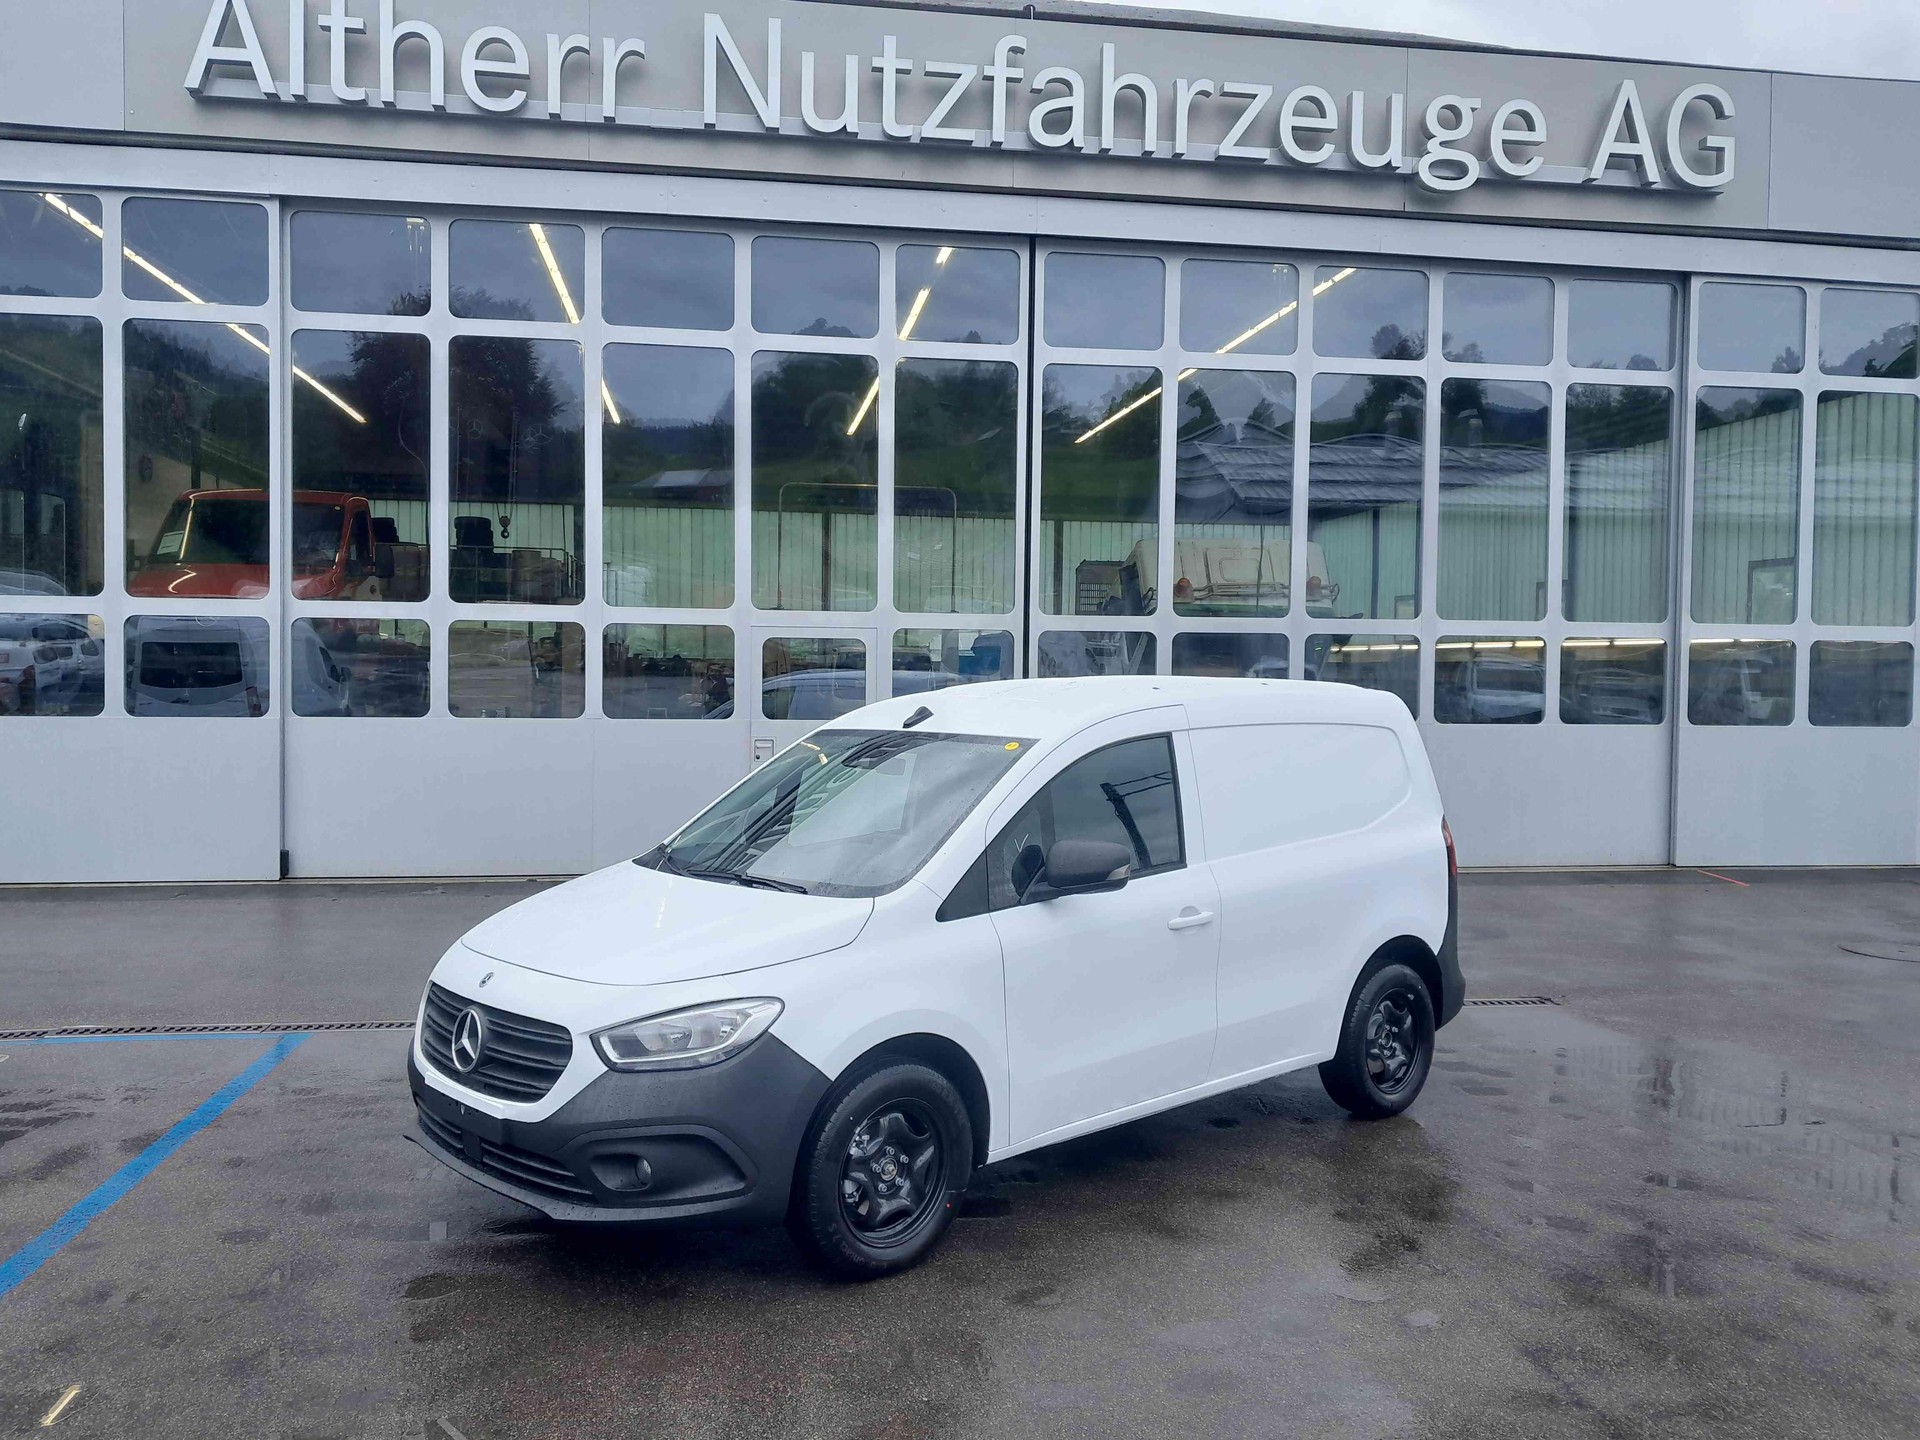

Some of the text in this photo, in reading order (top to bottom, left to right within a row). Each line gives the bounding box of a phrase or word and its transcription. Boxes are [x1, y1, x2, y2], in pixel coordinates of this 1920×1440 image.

[184, 0, 1736, 194] Altherr Nutzfahrzeuge AG
